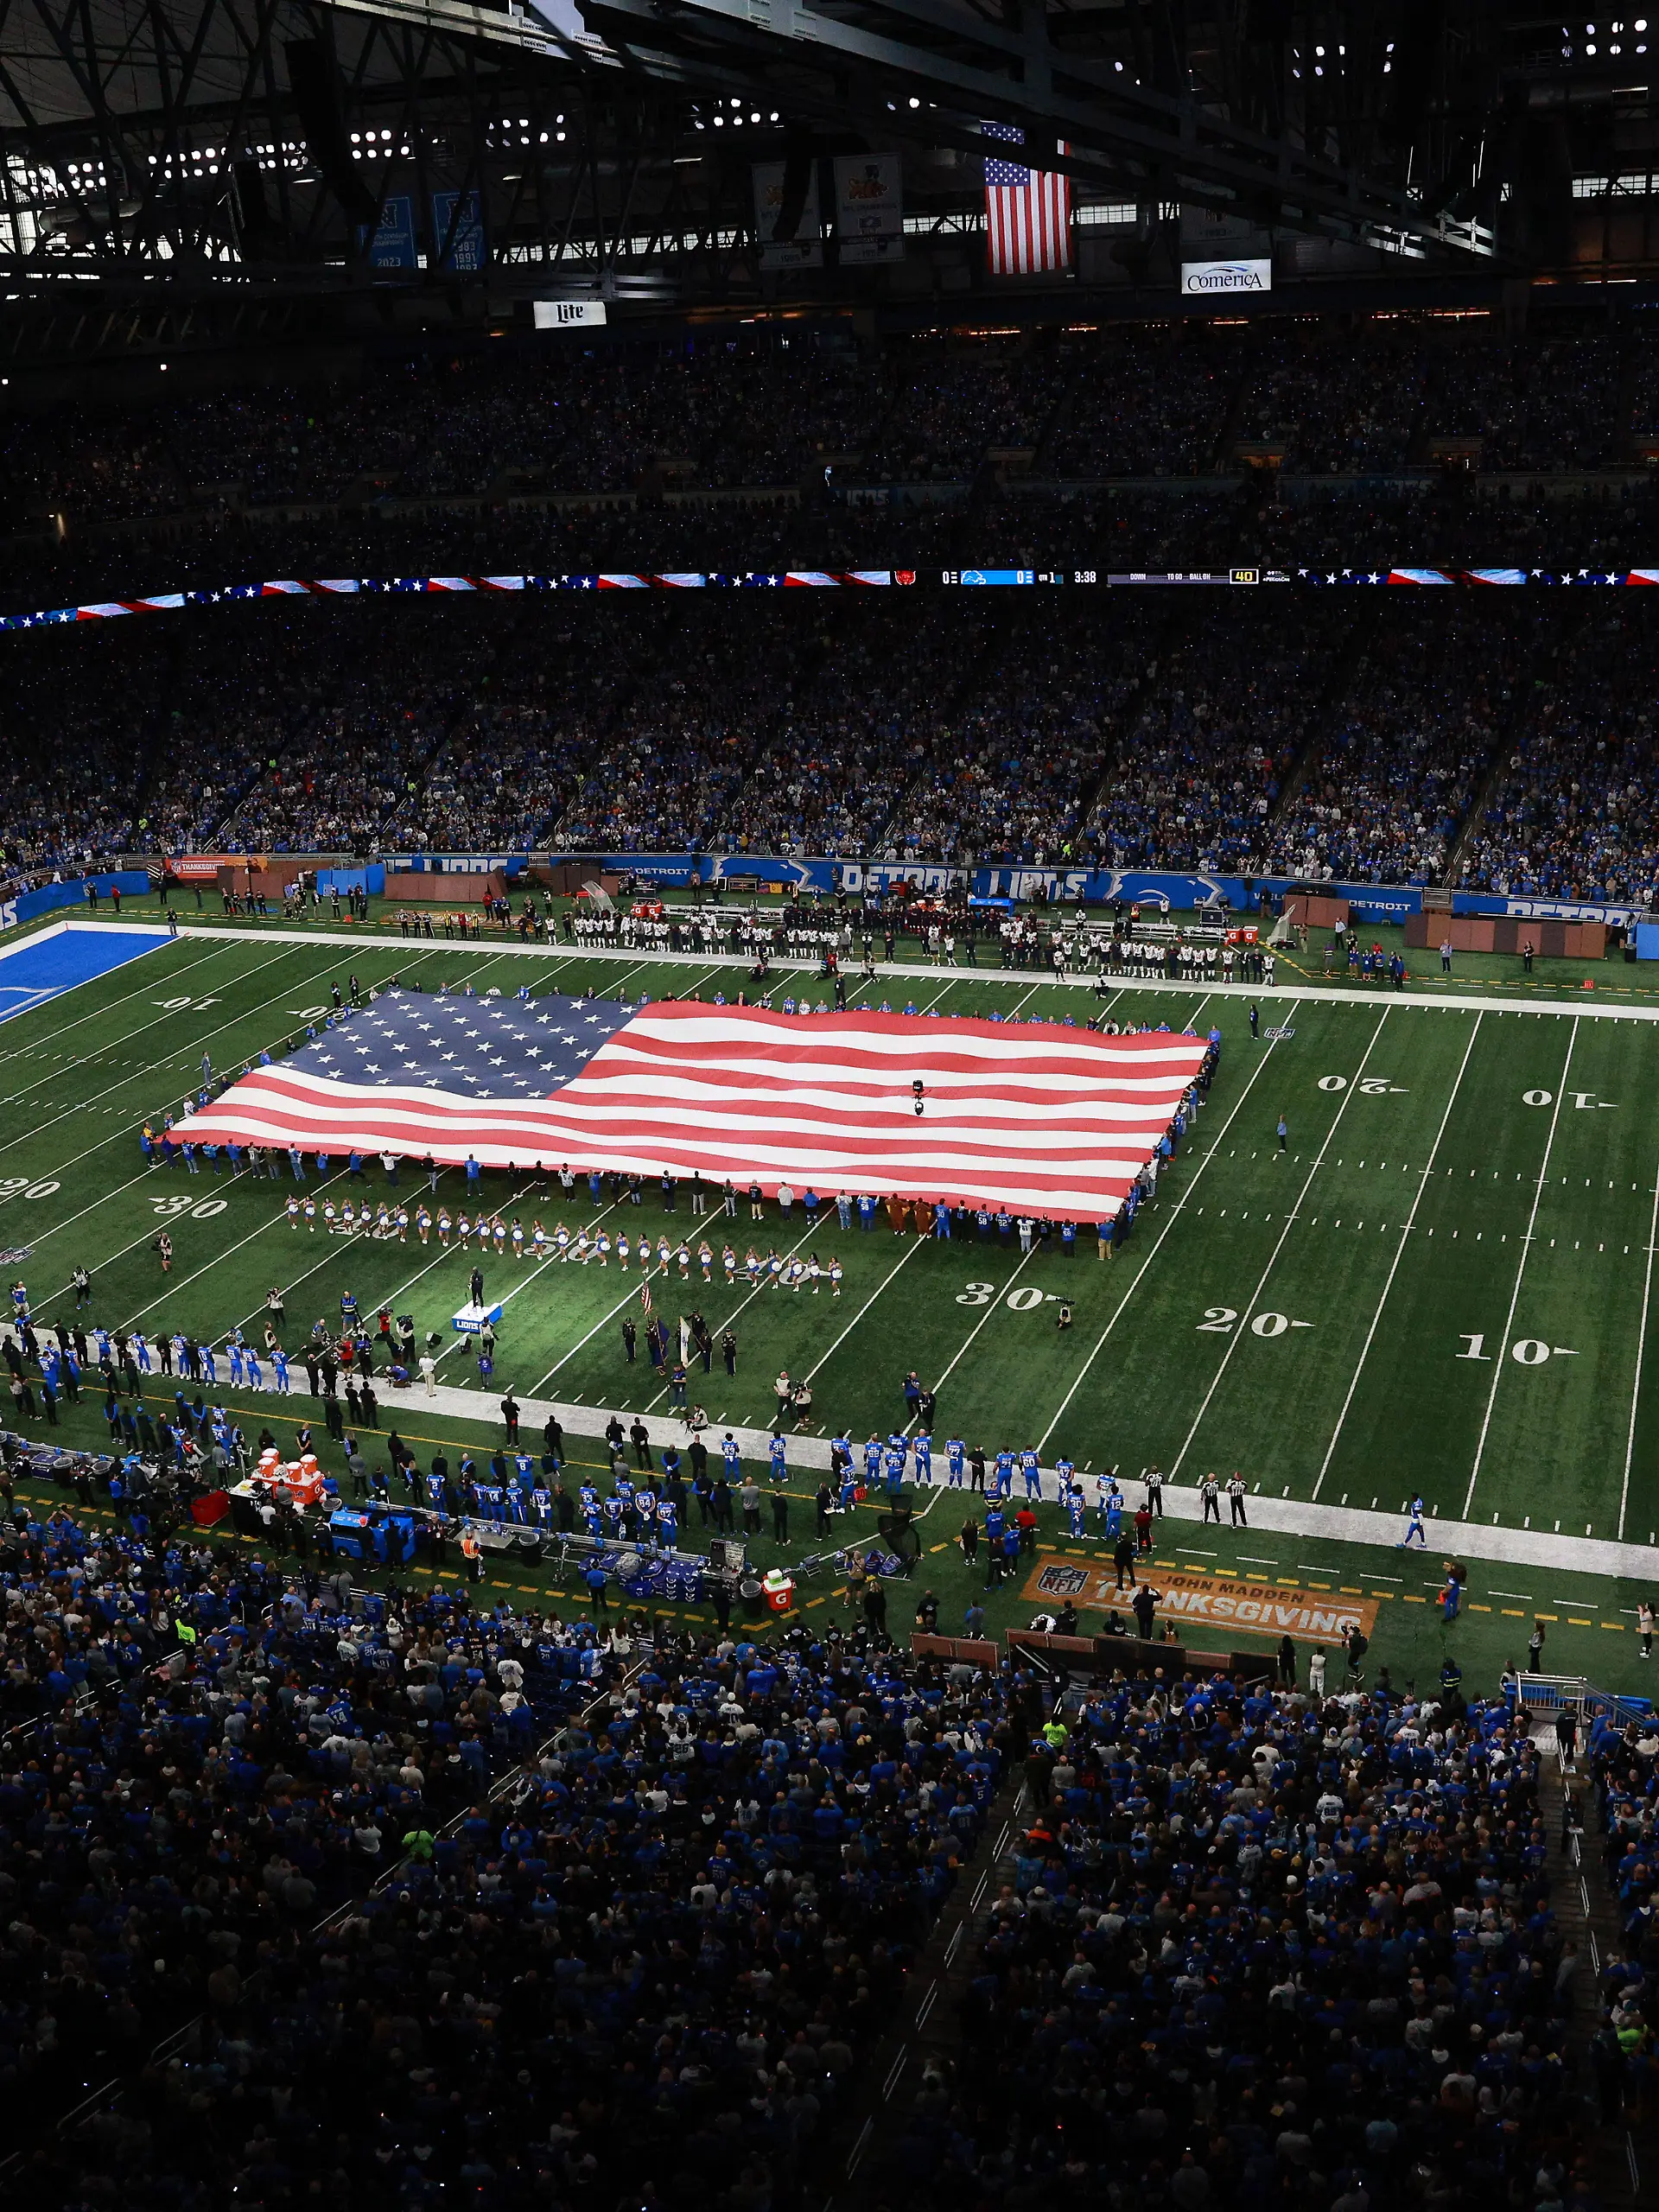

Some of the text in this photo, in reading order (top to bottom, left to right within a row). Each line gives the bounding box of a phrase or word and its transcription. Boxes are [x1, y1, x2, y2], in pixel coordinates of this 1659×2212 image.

[377, 257, 402, 267] 2023
[454, 252, 476, 263] 1991
[556, 304, 583, 324] Lite
[942, 570, 950, 584] 0
[1017, 570, 1024, 584] 0
[1049, 572, 1056, 583] 1
[1074, 570, 1096, 583] 3:38
[1236, 571, 1254, 583] 40
[1349, 900, 1411, 912] DETROIT
[162, 995, 224, 1012] 10
[1318, 1074, 1392, 1095] 20
[1522, 1090, 1597, 1109] 10
[0, 1177, 61, 1199] 20
[152, 1195, 229, 1219] 30
[955, 1282, 1046, 1311] 30
[456, 1320, 479, 1331] LIONS
[1196, 1307, 1291, 1338] 20
[1455, 1334, 1551, 1365] 10
[1023, 1459, 1036, 1468] 60
[489, 1492, 499, 1502] 14
[537, 1496, 546, 1505] 17
[582, 1495, 594, 1503] 33
[1071, 1500, 1083, 1509] 30
[1111, 1501, 1122, 1510] 12
[1041, 1575, 1090, 1592] NFL
[1169, 1575, 1305, 1604] JOHN MADDEN
[776, 1592, 787, 1605] G
[333, 1710, 347, 1726] 14
